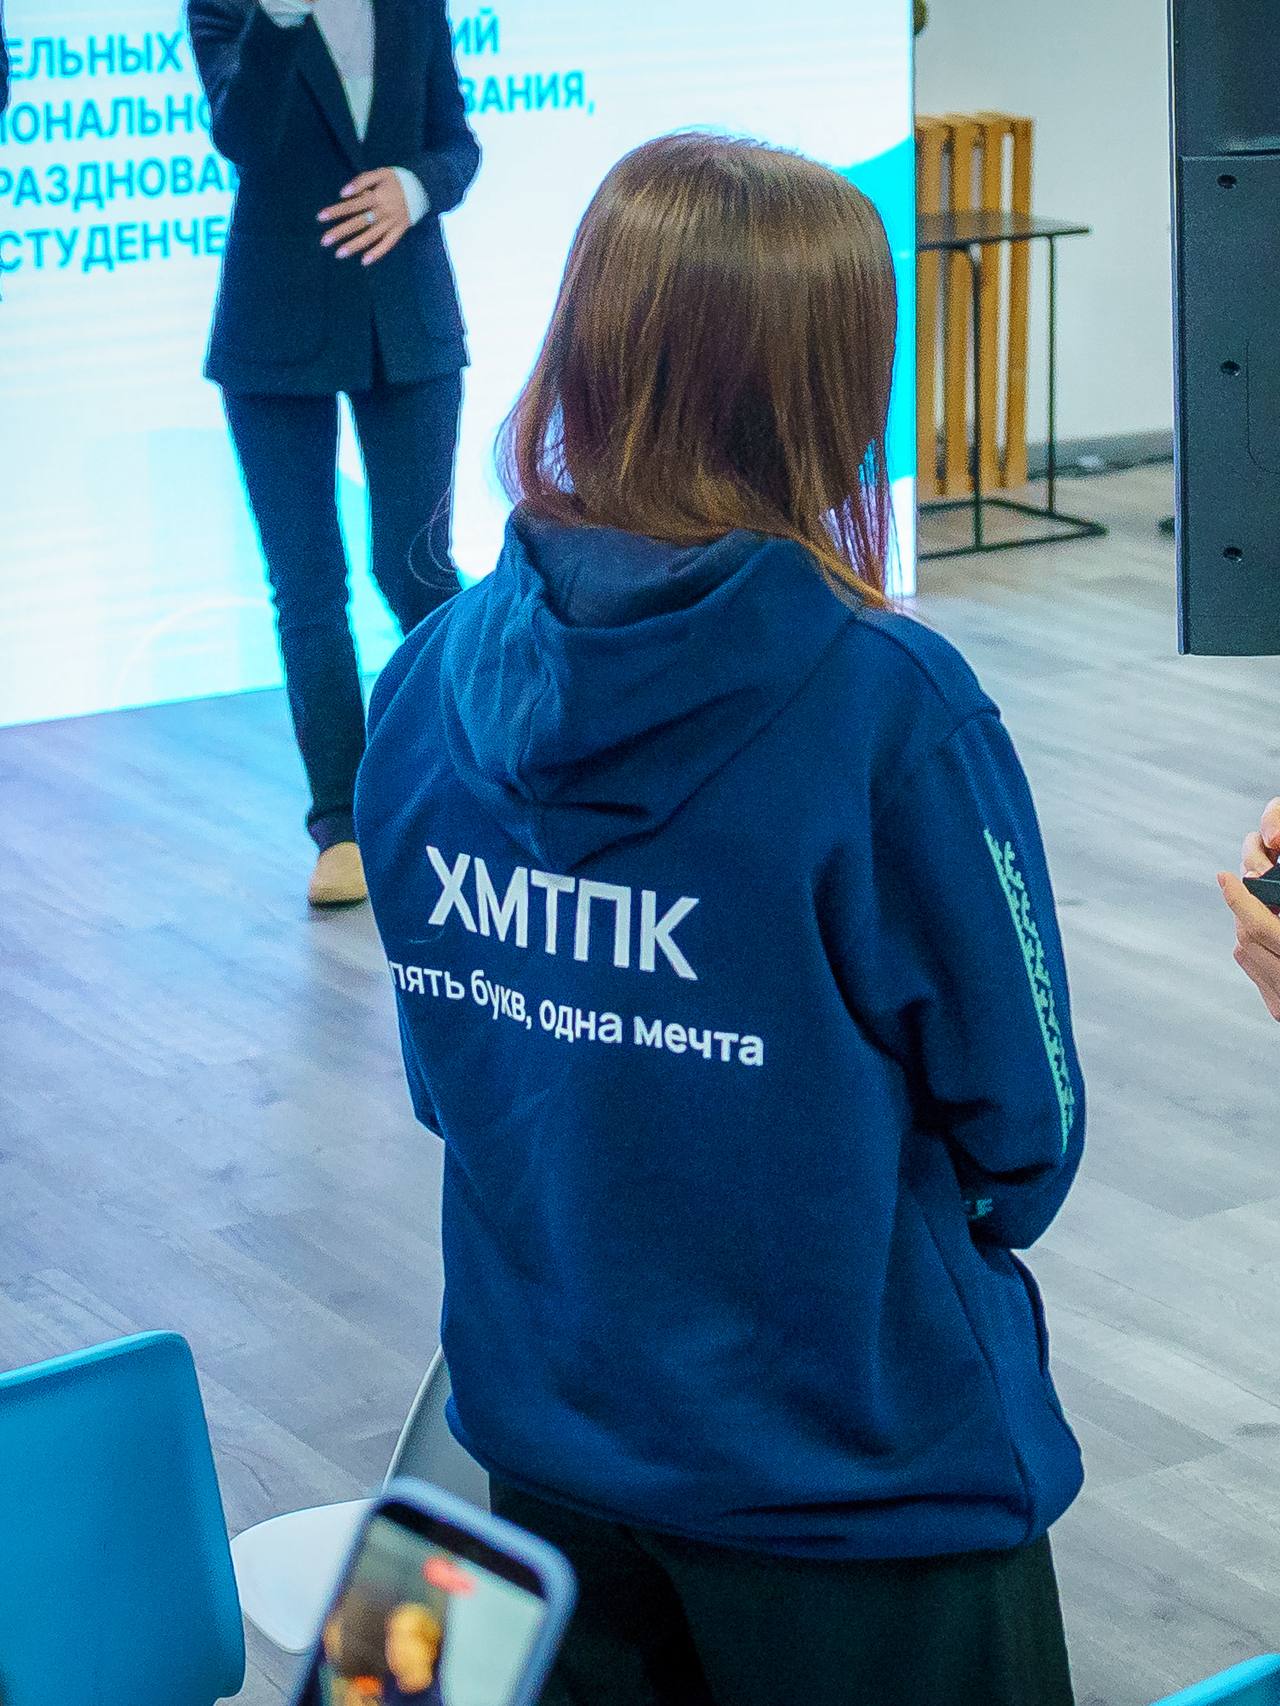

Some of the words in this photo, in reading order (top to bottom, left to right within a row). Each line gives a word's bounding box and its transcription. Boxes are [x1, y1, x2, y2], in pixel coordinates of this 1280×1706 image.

[0, 154, 239, 213] РАЗДНОВА
[0, 215, 227, 273] СТУДЕНЧЕ
[426, 845, 699, 981] ХМТПК
[389, 960, 466, 1000] пять
[470, 969, 533, 1031] букв,
[538, 999, 623, 1044] одна
[633, 1015, 765, 1067] мечта
